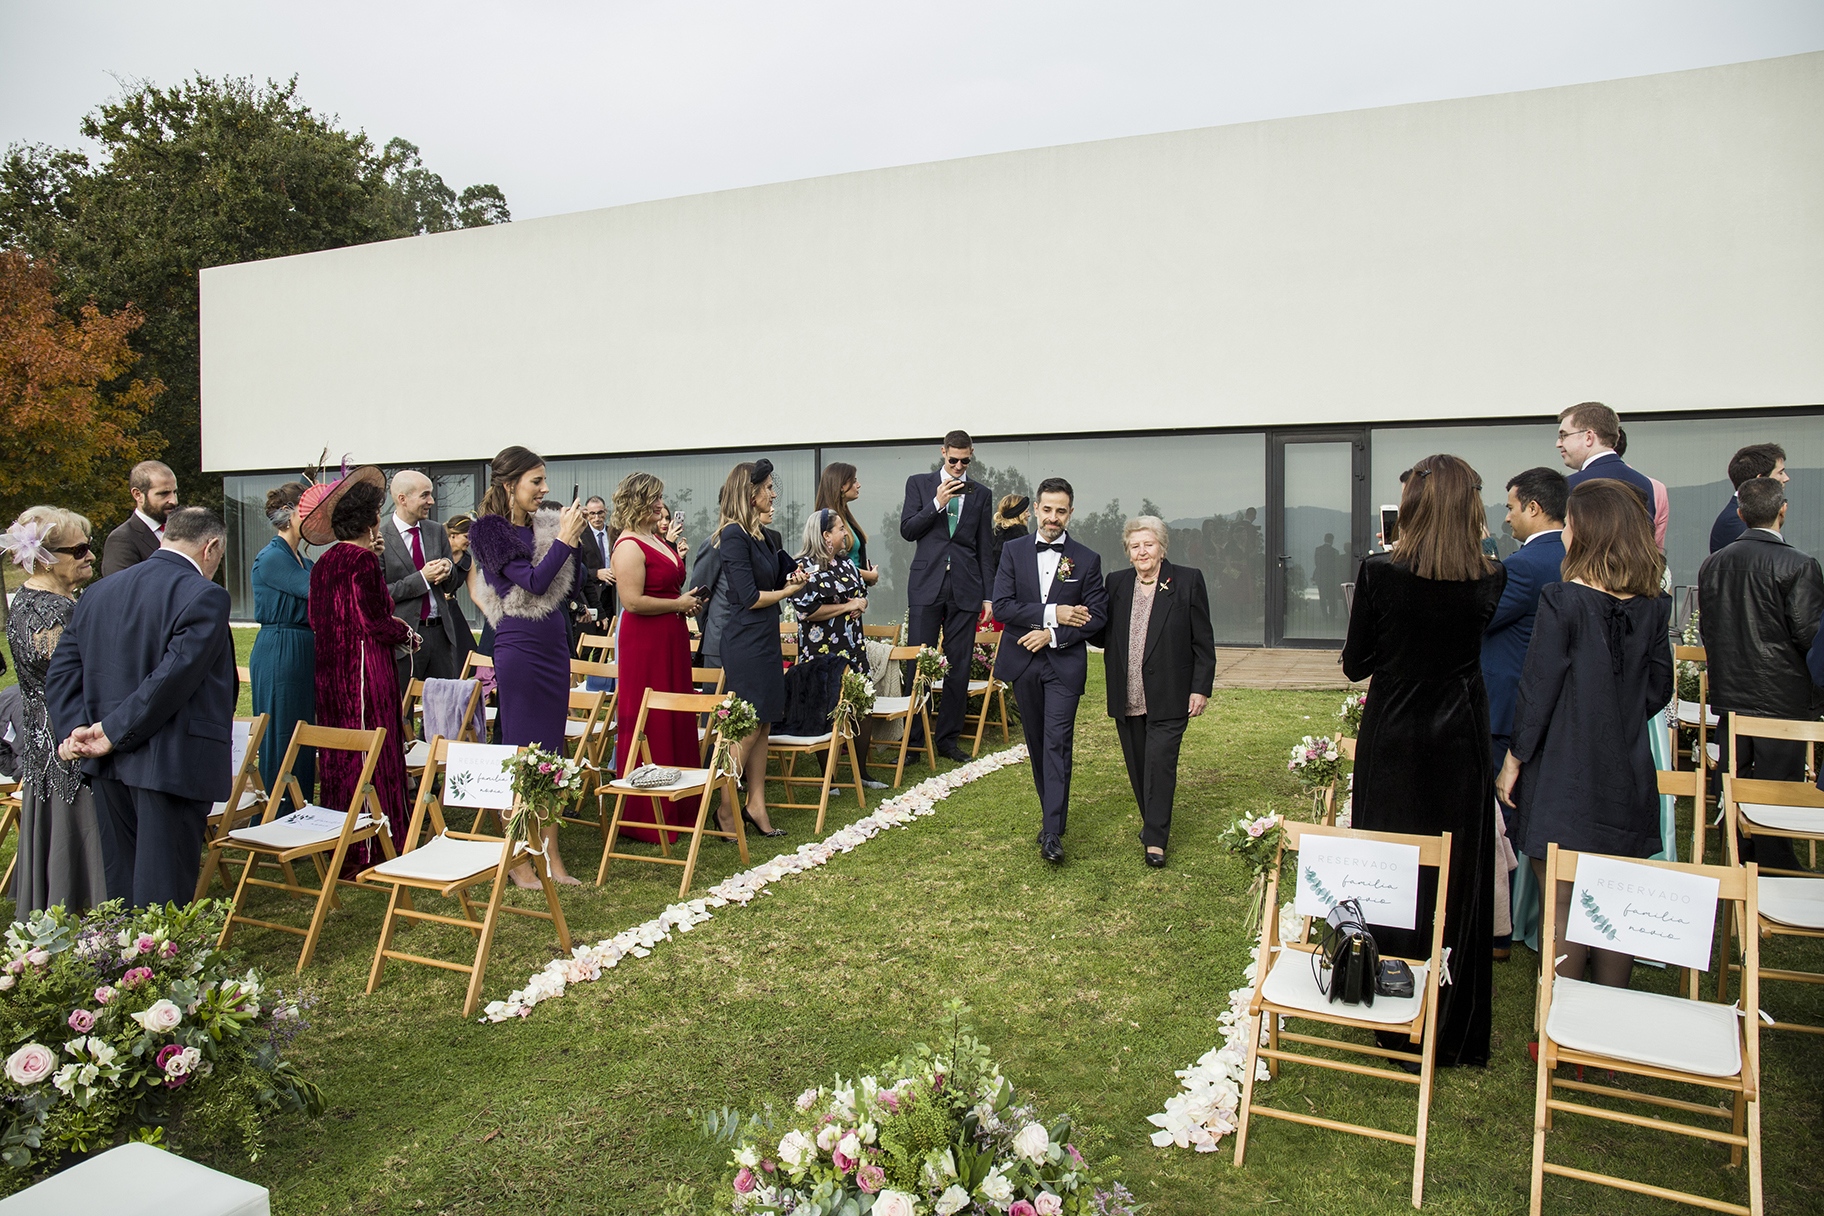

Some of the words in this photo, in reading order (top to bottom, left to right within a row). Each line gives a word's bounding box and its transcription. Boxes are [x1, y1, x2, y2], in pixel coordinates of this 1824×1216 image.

[458, 757, 500, 766] RESERVAD
[1318, 855, 1398, 871] RESERVADO
[1341, 874, 1398, 890] familia
[1596, 877, 1691, 904] RESERVADO
[1623, 902, 1690, 925] familia
[1628, 926, 1681, 940] novio
